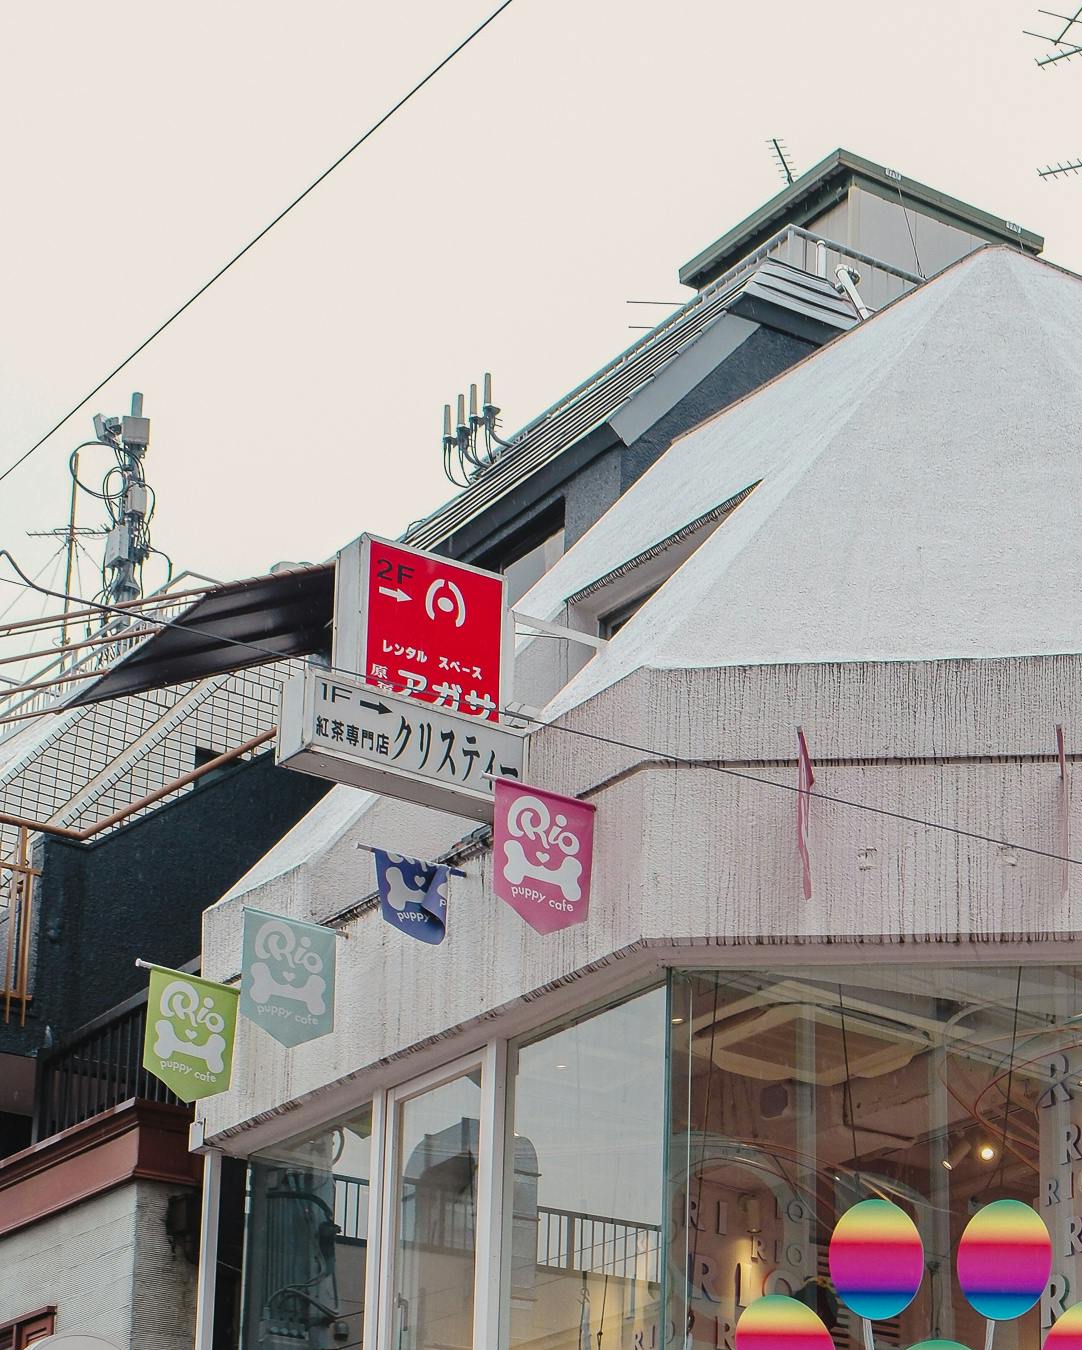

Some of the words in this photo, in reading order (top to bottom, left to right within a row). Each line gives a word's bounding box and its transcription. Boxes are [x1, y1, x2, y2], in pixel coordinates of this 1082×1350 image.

[376, 559, 414, 584] 2F
[382, 639, 428, 663] レンタル
[438, 656, 483, 680] スペース
[322, 683, 352, 703] 1F
[397, 669, 497, 721] アガサ
[316, 715, 389, 756] 紅茶専門店
[507, 796, 581, 855] Rio
[511, 885, 546, 903] puppy
[548, 898, 575, 913] cafe
[254, 920, 323, 973] Rio
[159, 981, 224, 1033] Rio
[256, 1003, 292, 1020] puppy
[295, 1012, 320, 1026] cafe
[160, 1059, 194, 1076] puppy
[194, 1070, 217, 1084] cafe
